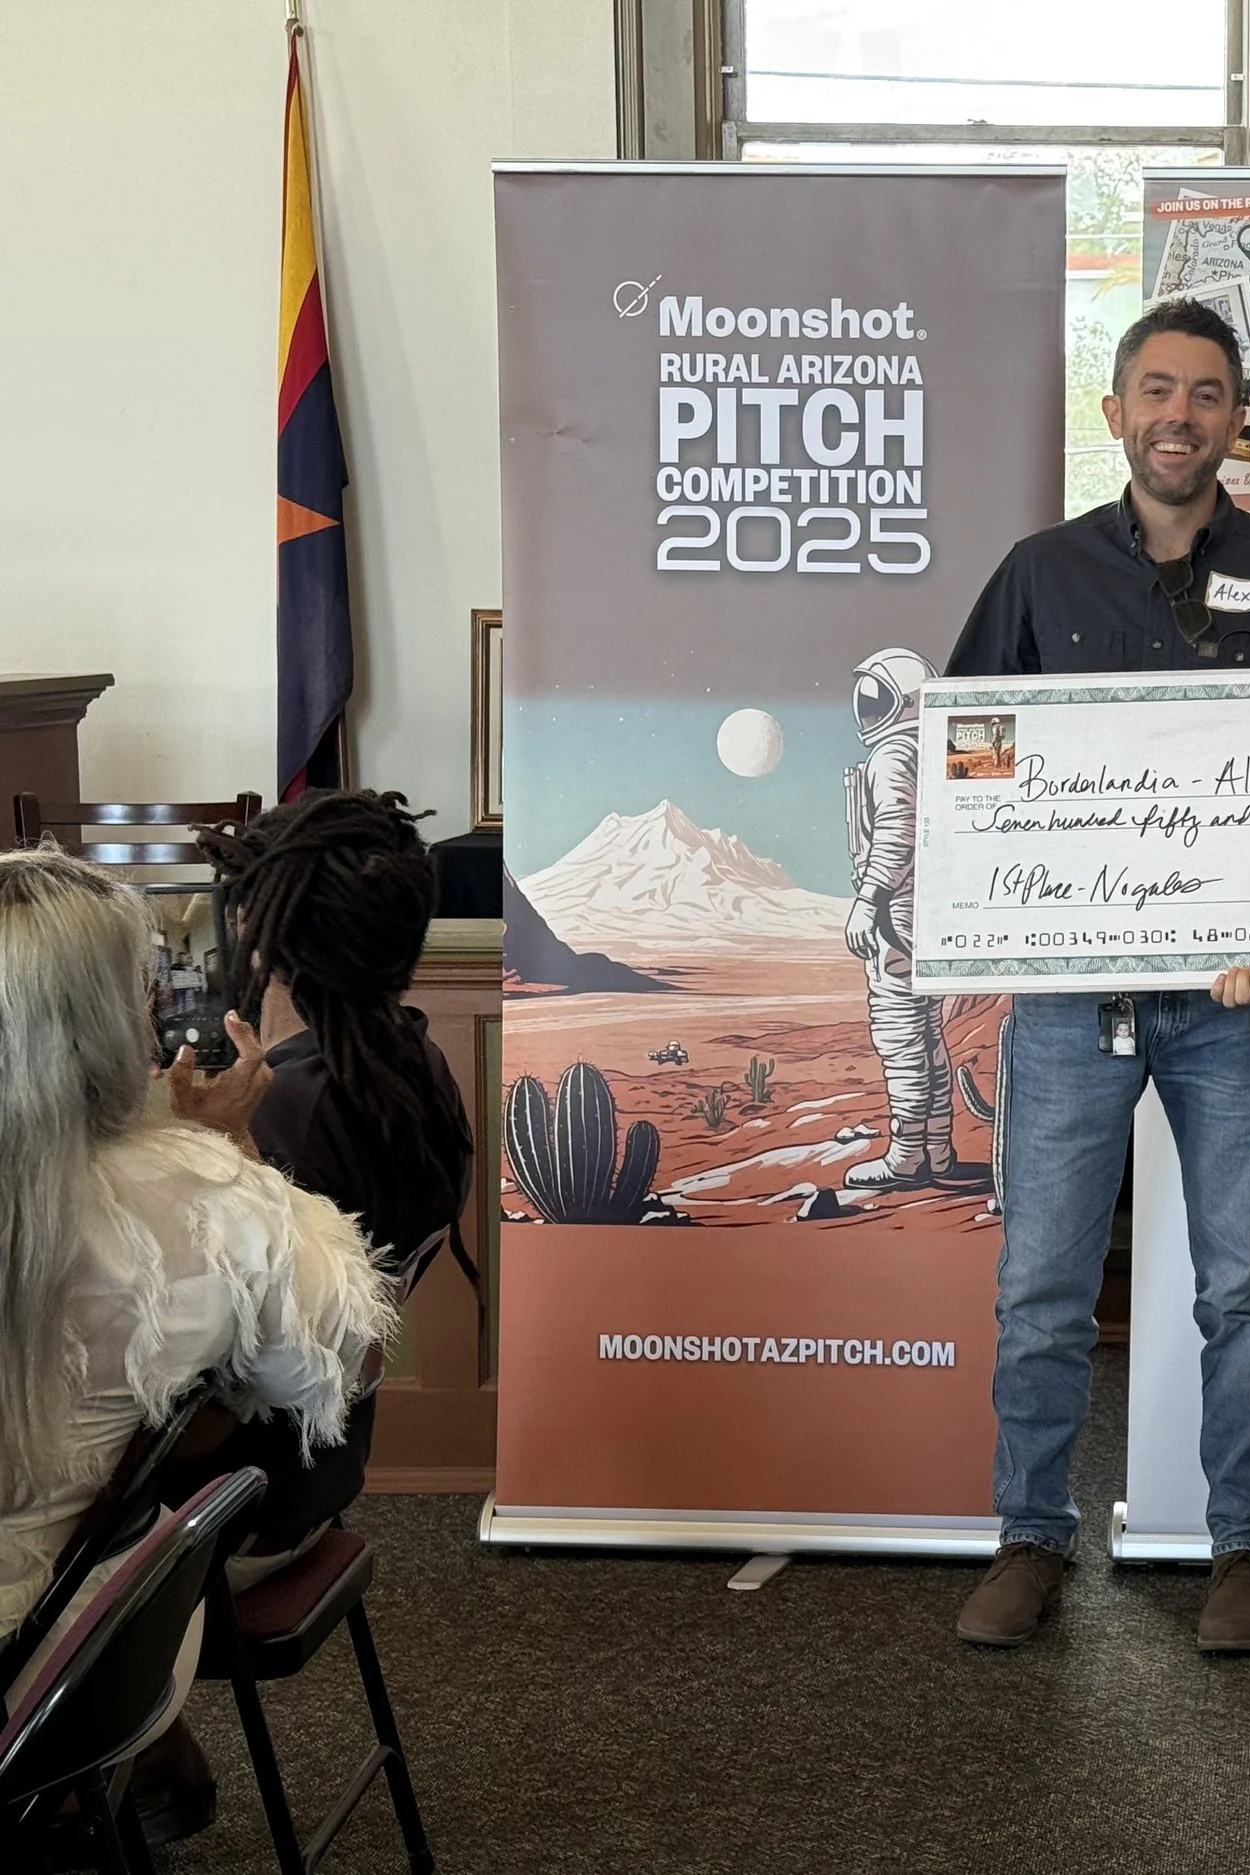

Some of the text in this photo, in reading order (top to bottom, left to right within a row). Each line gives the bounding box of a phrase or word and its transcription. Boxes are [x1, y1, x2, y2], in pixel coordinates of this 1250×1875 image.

[1157, 202, 1183, 213] JOIN
[1186, 201, 1200, 211] US
[1203, 200, 1218, 210] ON
[1220, 198, 1244, 209] THE
[1202, 257, 1244, 269] ARIZONA
[660, 353, 923, 385] RURAL ARIZONA
[660, 387, 923, 466] PITCH
[656, 467, 922, 504] COMPETITION
[656, 505, 931, 574] 2025
[957, 731, 985, 740] PITCH
[1015, 754, 1179, 802] Borderlandia
[955, 803, 984, 811] ORDER
[985, 794, 1001, 802] THE
[952, 901, 979, 909] MEMO
[599, 1333, 955, 1367] MOONSHOTAZPITCH.COM
